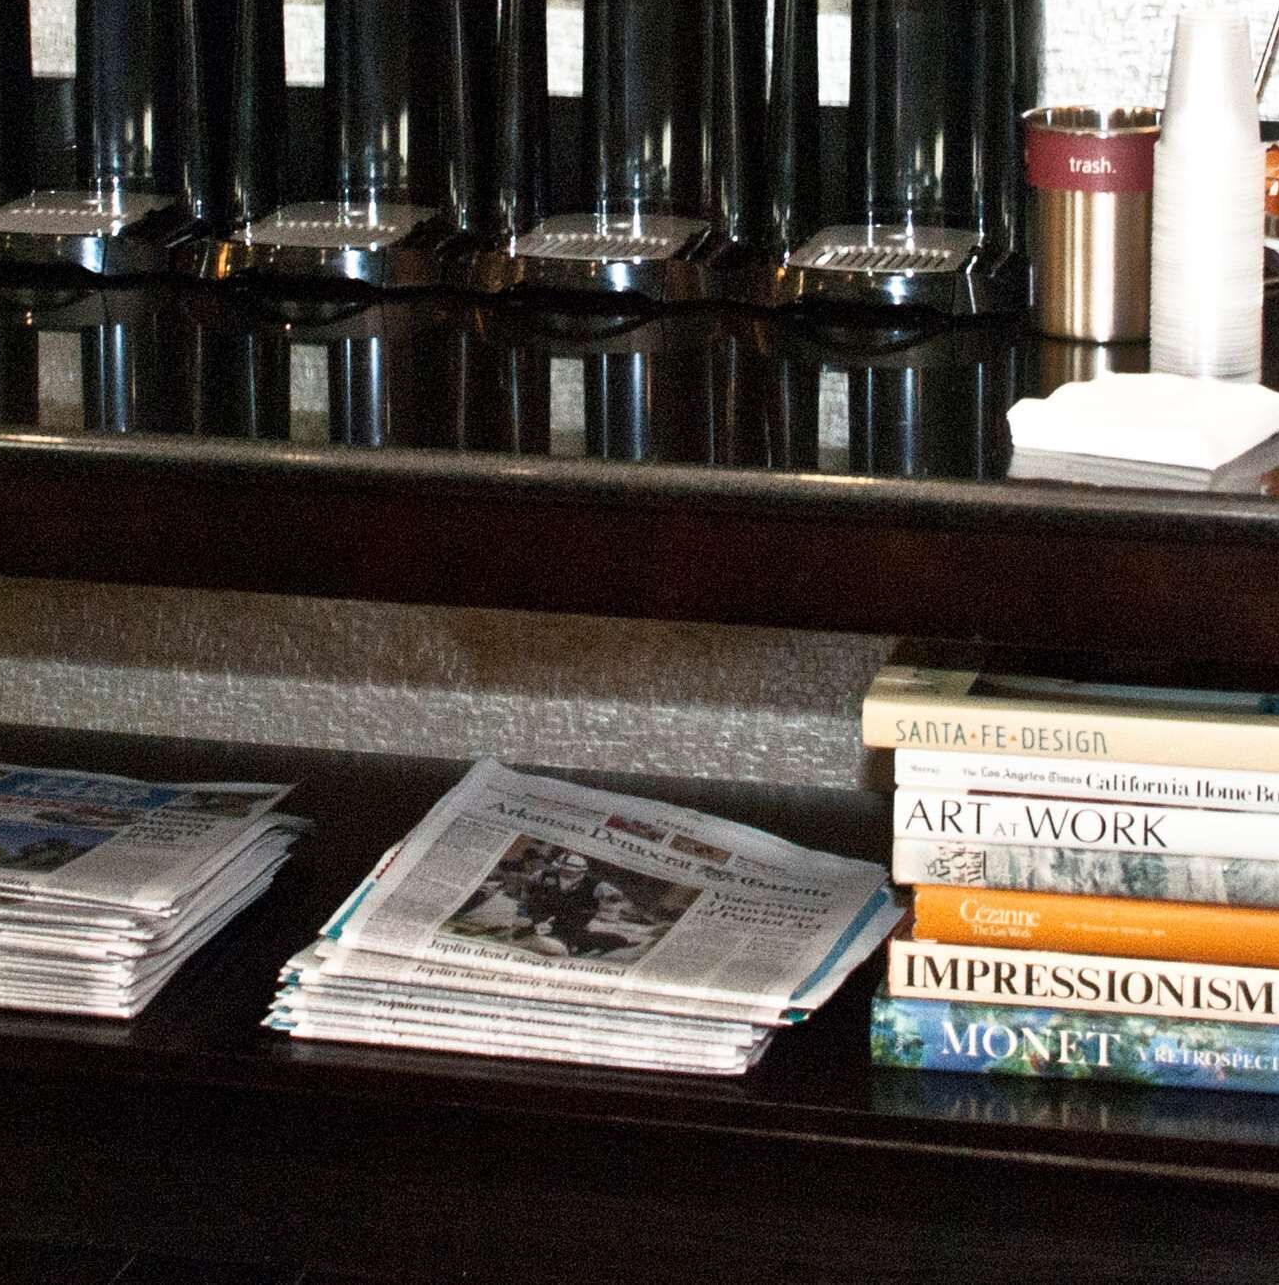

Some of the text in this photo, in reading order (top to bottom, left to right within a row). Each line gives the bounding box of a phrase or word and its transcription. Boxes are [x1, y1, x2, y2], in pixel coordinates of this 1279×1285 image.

[1069, 156, 1117, 174] trash.
[895, 719, 1108, 754] SANTA FE DESIGN
[980, 765, 1000, 779] Los
[1002, 768, 1046, 783] Angeles
[1048, 771, 1082, 784] Times
[1086, 772, 1189, 797] California
[1196, 780, 1252, 802] Home
[486, 801, 587, 836] Arkansas
[589, 827, 693, 870] Democrat
[905, 798, 1168, 849] ART AT WORK
[414, 964, 457, 980] Joplin
[460, 969, 498, 983] dead
[428, 938, 471, 955] Joplin
[474, 946, 511, 962] dead
[558, 960, 627, 977] identified
[905, 954, 1275, 1015] IMPRESSIONISM
[941, 1021, 1121, 1067] MONET
[1136, 1046, 1148, 1063] A
